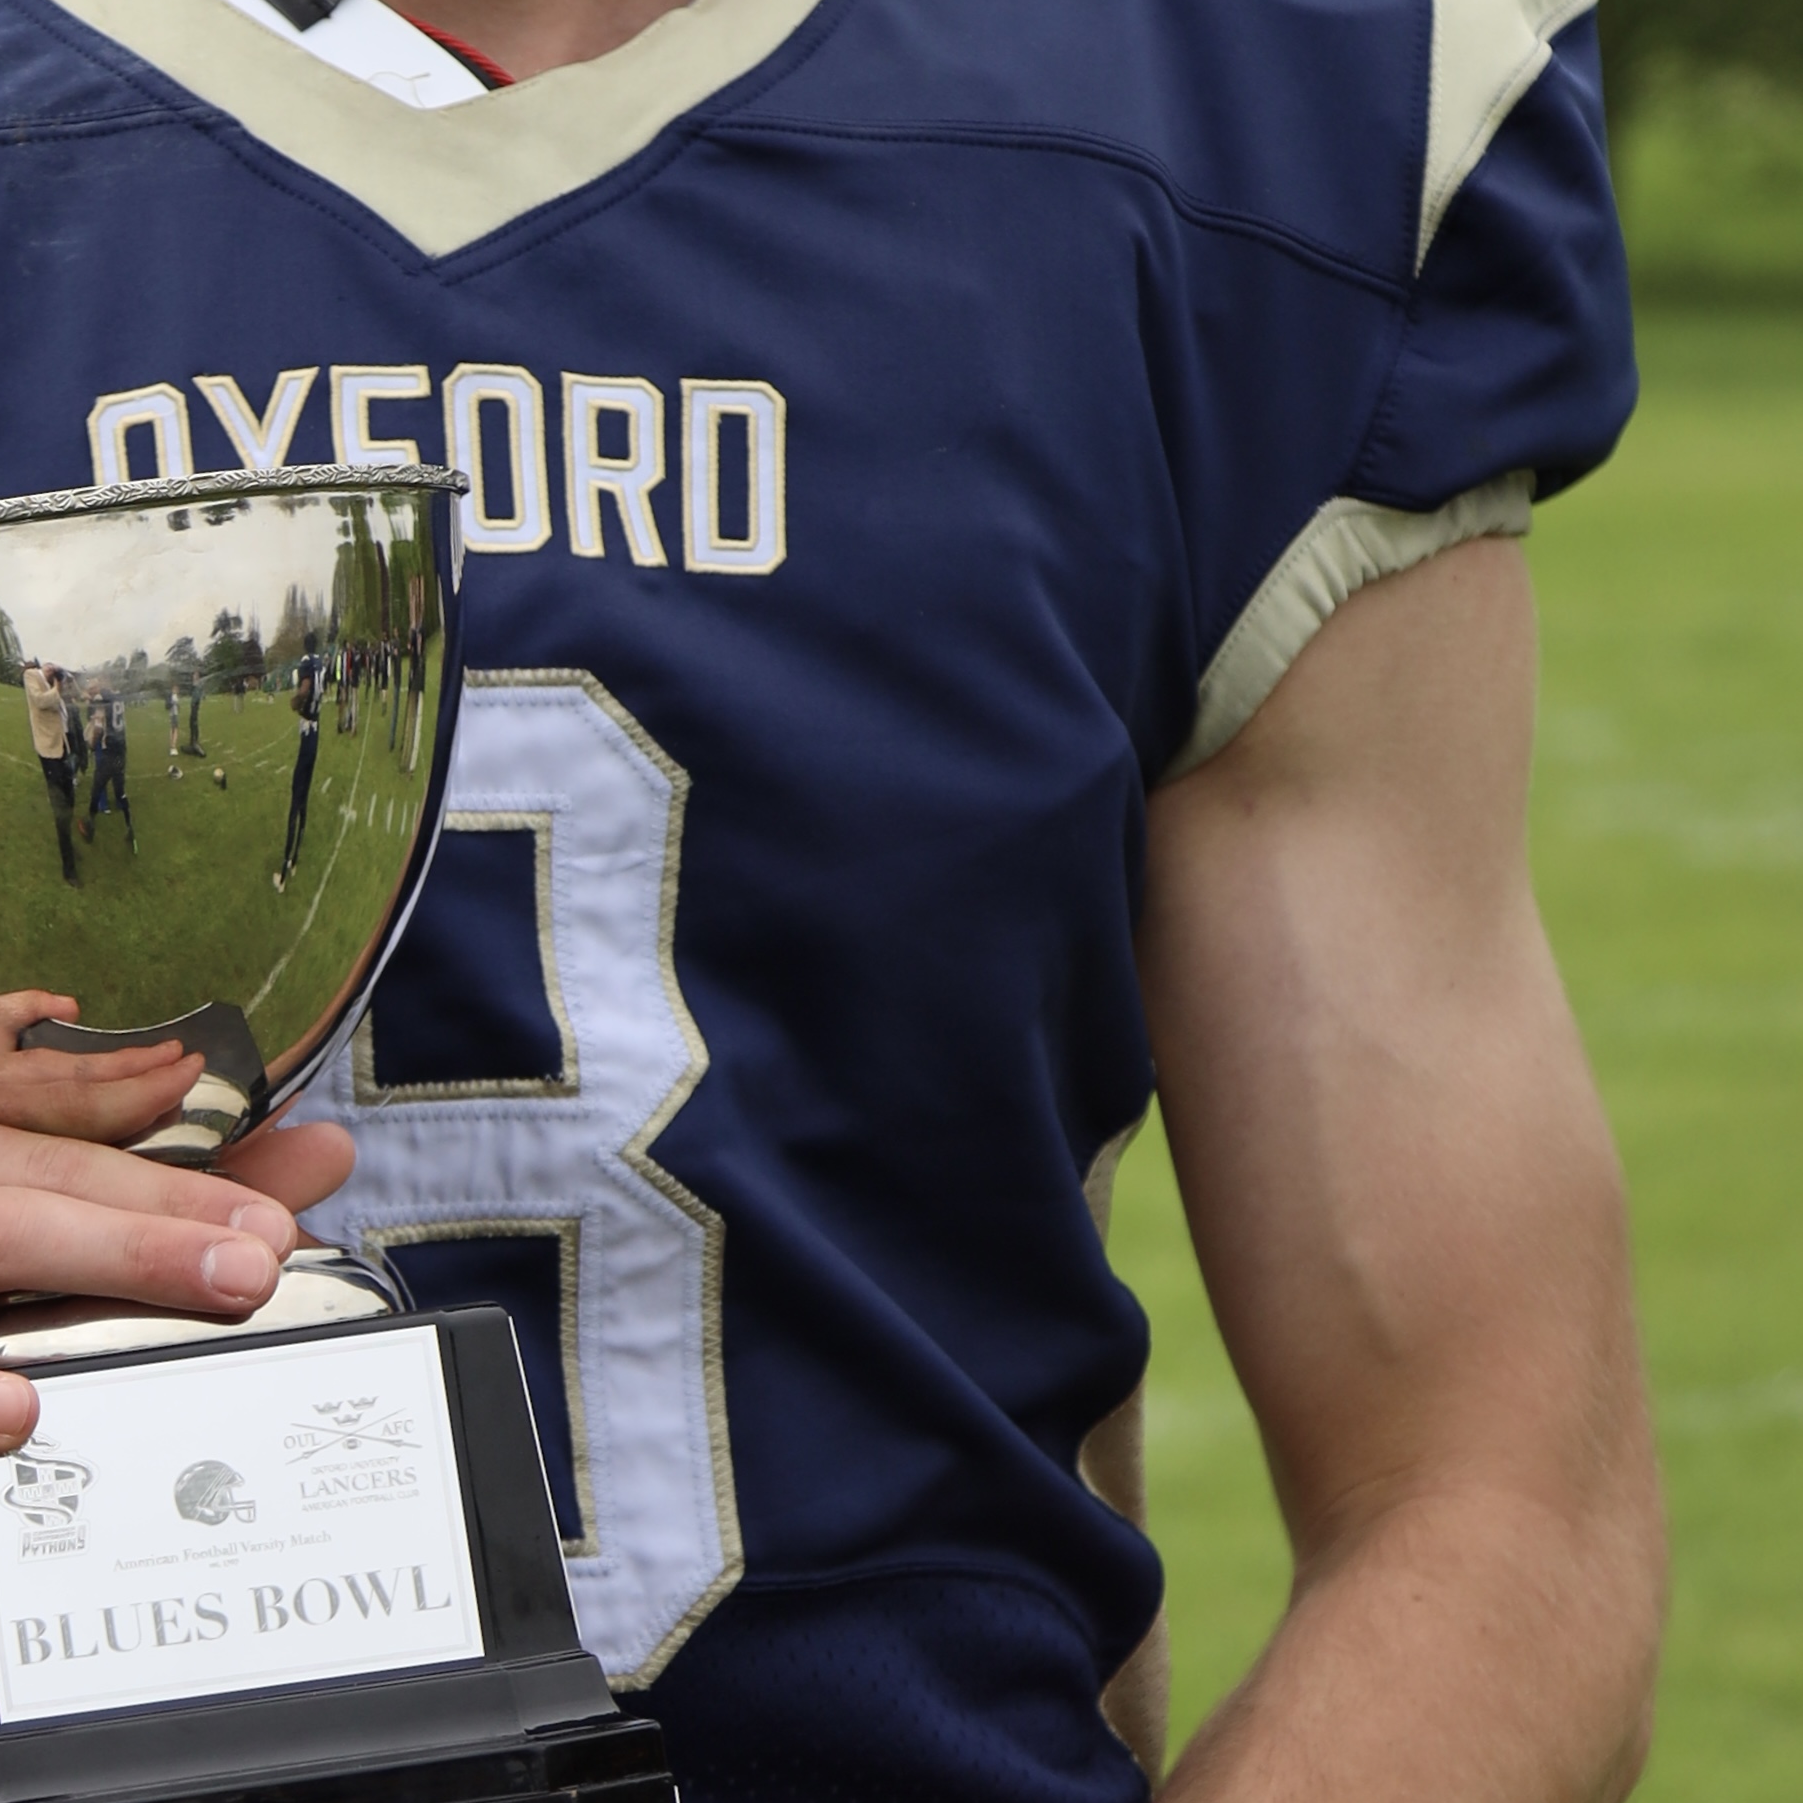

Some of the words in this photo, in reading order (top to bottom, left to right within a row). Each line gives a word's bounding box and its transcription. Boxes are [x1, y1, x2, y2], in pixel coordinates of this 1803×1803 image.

[283, 1433, 321, 1449] OUL
[381, 1420, 415, 1437] AFC
[299, 1466, 418, 1499] LANCERS
[350, 1493, 396, 1505] FOOTBALL
[113, 1554, 179, 1572] American
[182, 1542, 238, 1562] Football
[239, 1536, 287, 1553] Varsity
[290, 1530, 332, 1548] Match
[10, 1590, 229, 1667] BLUES
[248, 1562, 453, 1633] BOWL
